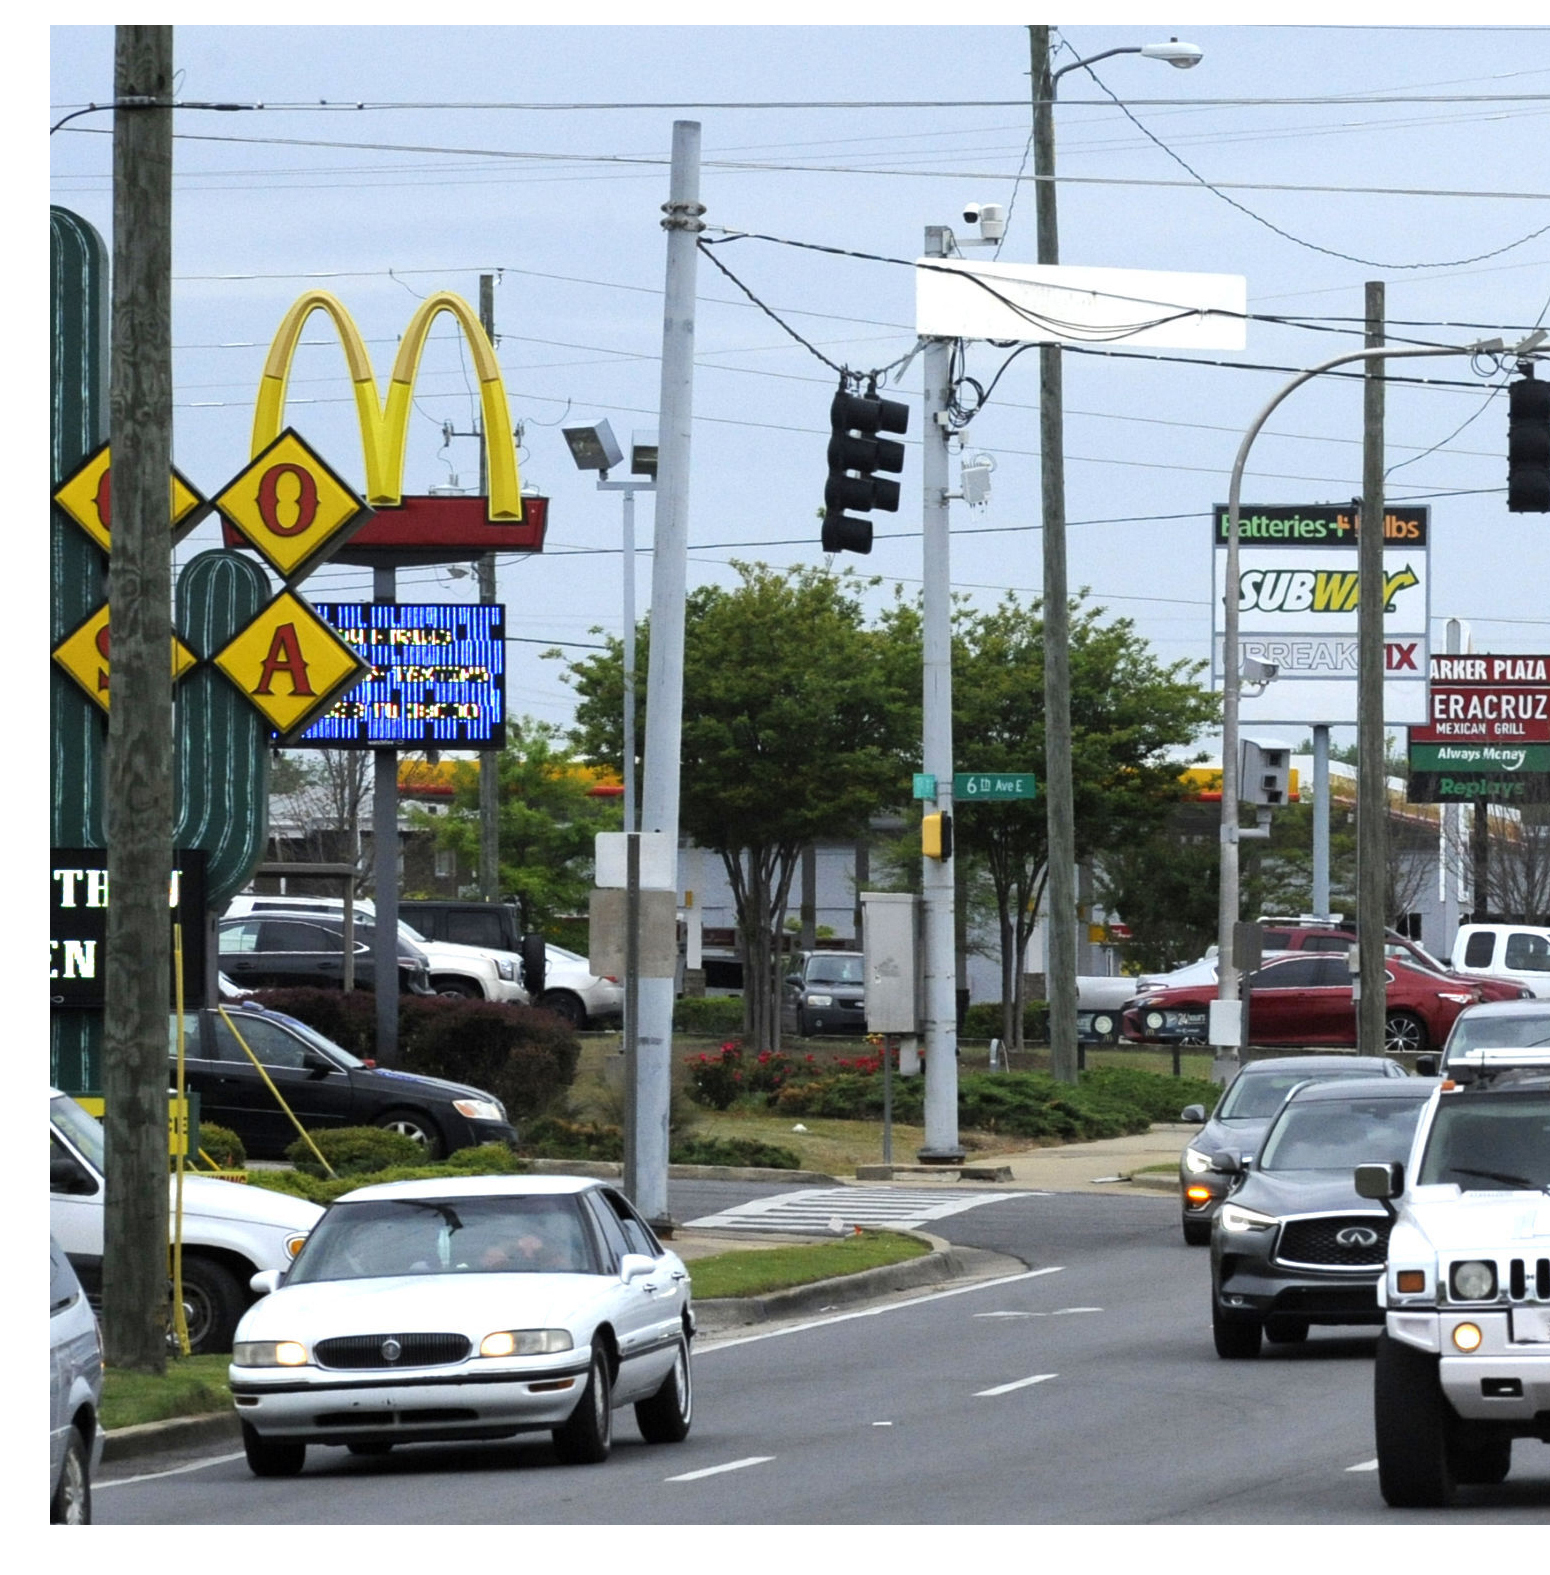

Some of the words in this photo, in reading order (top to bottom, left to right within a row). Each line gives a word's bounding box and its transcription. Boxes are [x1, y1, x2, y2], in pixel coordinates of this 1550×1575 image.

[1354, 514, 1420, 538] lbs
[1494, 659, 1547, 680] PLAZA
[1430, 694, 1548, 720] ERACRUZ
[1436, 722, 1486, 735] MEXICAN
[1494, 722, 1526, 735] GRILL
[1437, 747, 1480, 762] Always
[995, 779, 1013, 792] Ave
[1016, 779, 1023, 792] E
[1439, 777, 1525, 799] Replays
